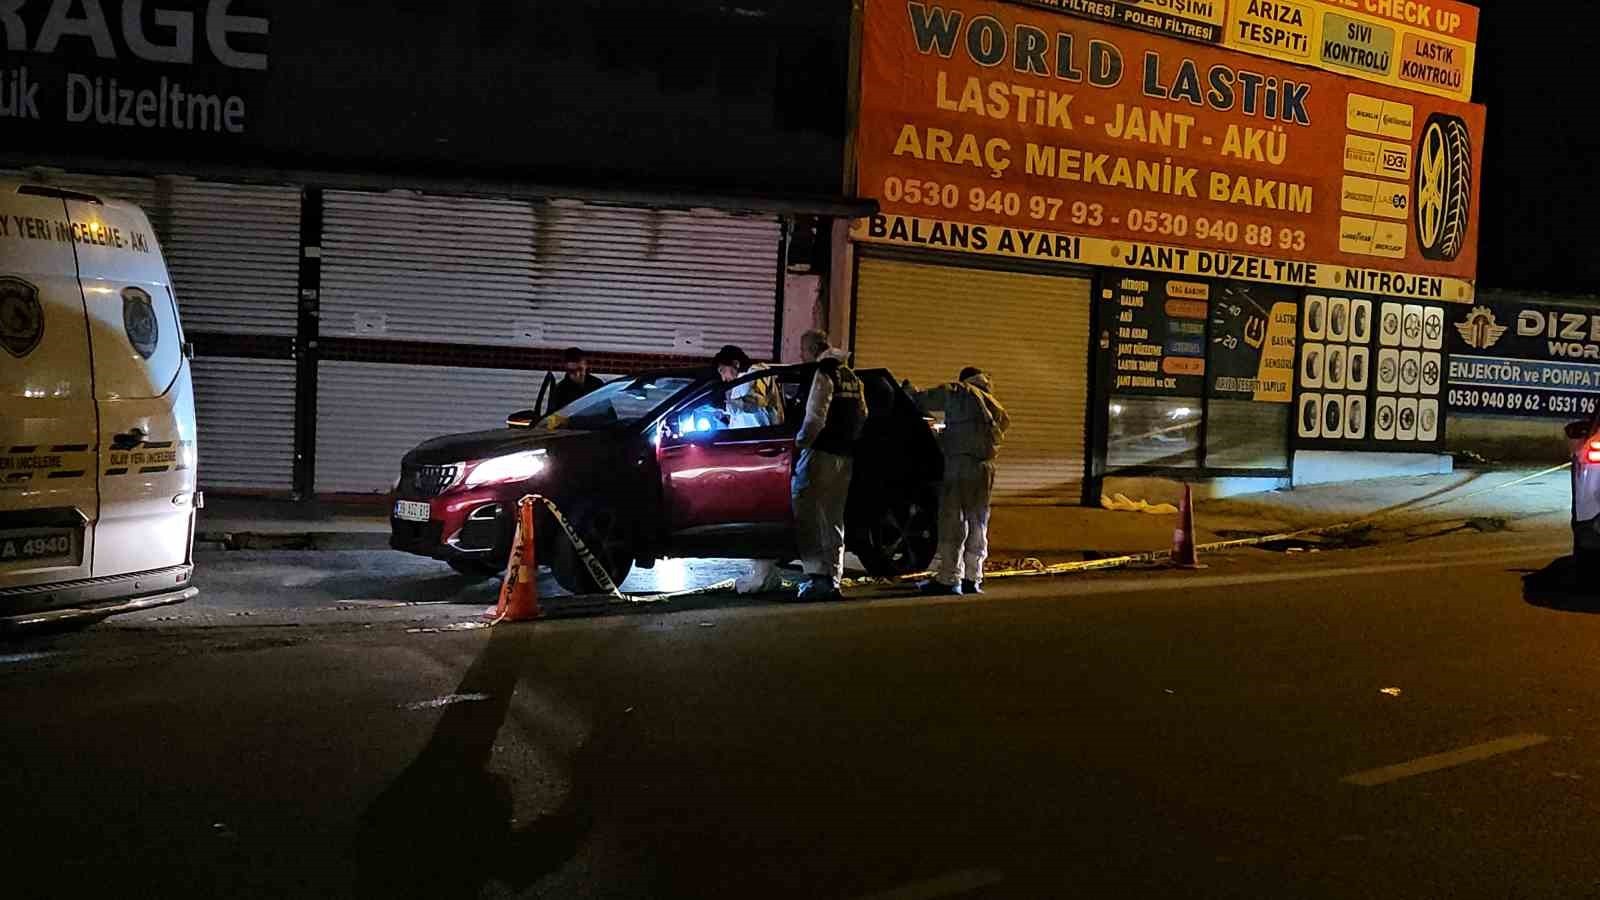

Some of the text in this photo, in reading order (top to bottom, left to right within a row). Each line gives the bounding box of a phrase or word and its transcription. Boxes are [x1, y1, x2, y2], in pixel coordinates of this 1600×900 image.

[1125, 10, 1162, 29] POLEN
[1247, 0, 1303, 27] ARIZA
[1364, 0, 1461, 33] CHECK UP
[908, 2, 1124, 88] WORLD
[1347, 22, 1373, 44] SIVI
[1323, 40, 1389, 71] KONTROLÜ
[1401, 61, 1461, 88] KONTROLÜ
[66, 73, 245, 133] Düzeltme
[1104, 103, 1195, 149] JANT
[1221, 124, 1287, 165] AKÜ
[893, 124, 1313, 214] ARAÇ MEKANİK BAKIM
[884, 176, 959, 208] 0530
[968, 187, 1020, 216] 940
[1029, 196, 1063, 221] 97
[1071, 201, 1104, 226] 93
[1127, 208, 1188, 236] 0530
[1195, 217, 1238, 243] 940
[1244, 224, 1273, 247] 88
[1279, 228, 1306, 251] 93
[868, 214, 1080, 259] BALANS AYARI
[1125, 244, 1317, 284] JANT DÜZELTME
[1345, 269, 1442, 297] NITROJEN
[1223, 334, 1238, 349] 20
[1449, 361, 1521, 381] ENJEKTÖR
[1524, 372, 1539, 382] ve
[1542, 368, 1591, 385] POMPA
[1449, 390, 1478, 406] 0530
[1482, 392, 1504, 408] 940
[1507, 393, 1522, 409] 89
[1524, 395, 1540, 410] 62
[1548, 396, 1577, 413] 0531
[1580, 398, 1598, 413] 96
[24, 537, 69, 555] 4940
